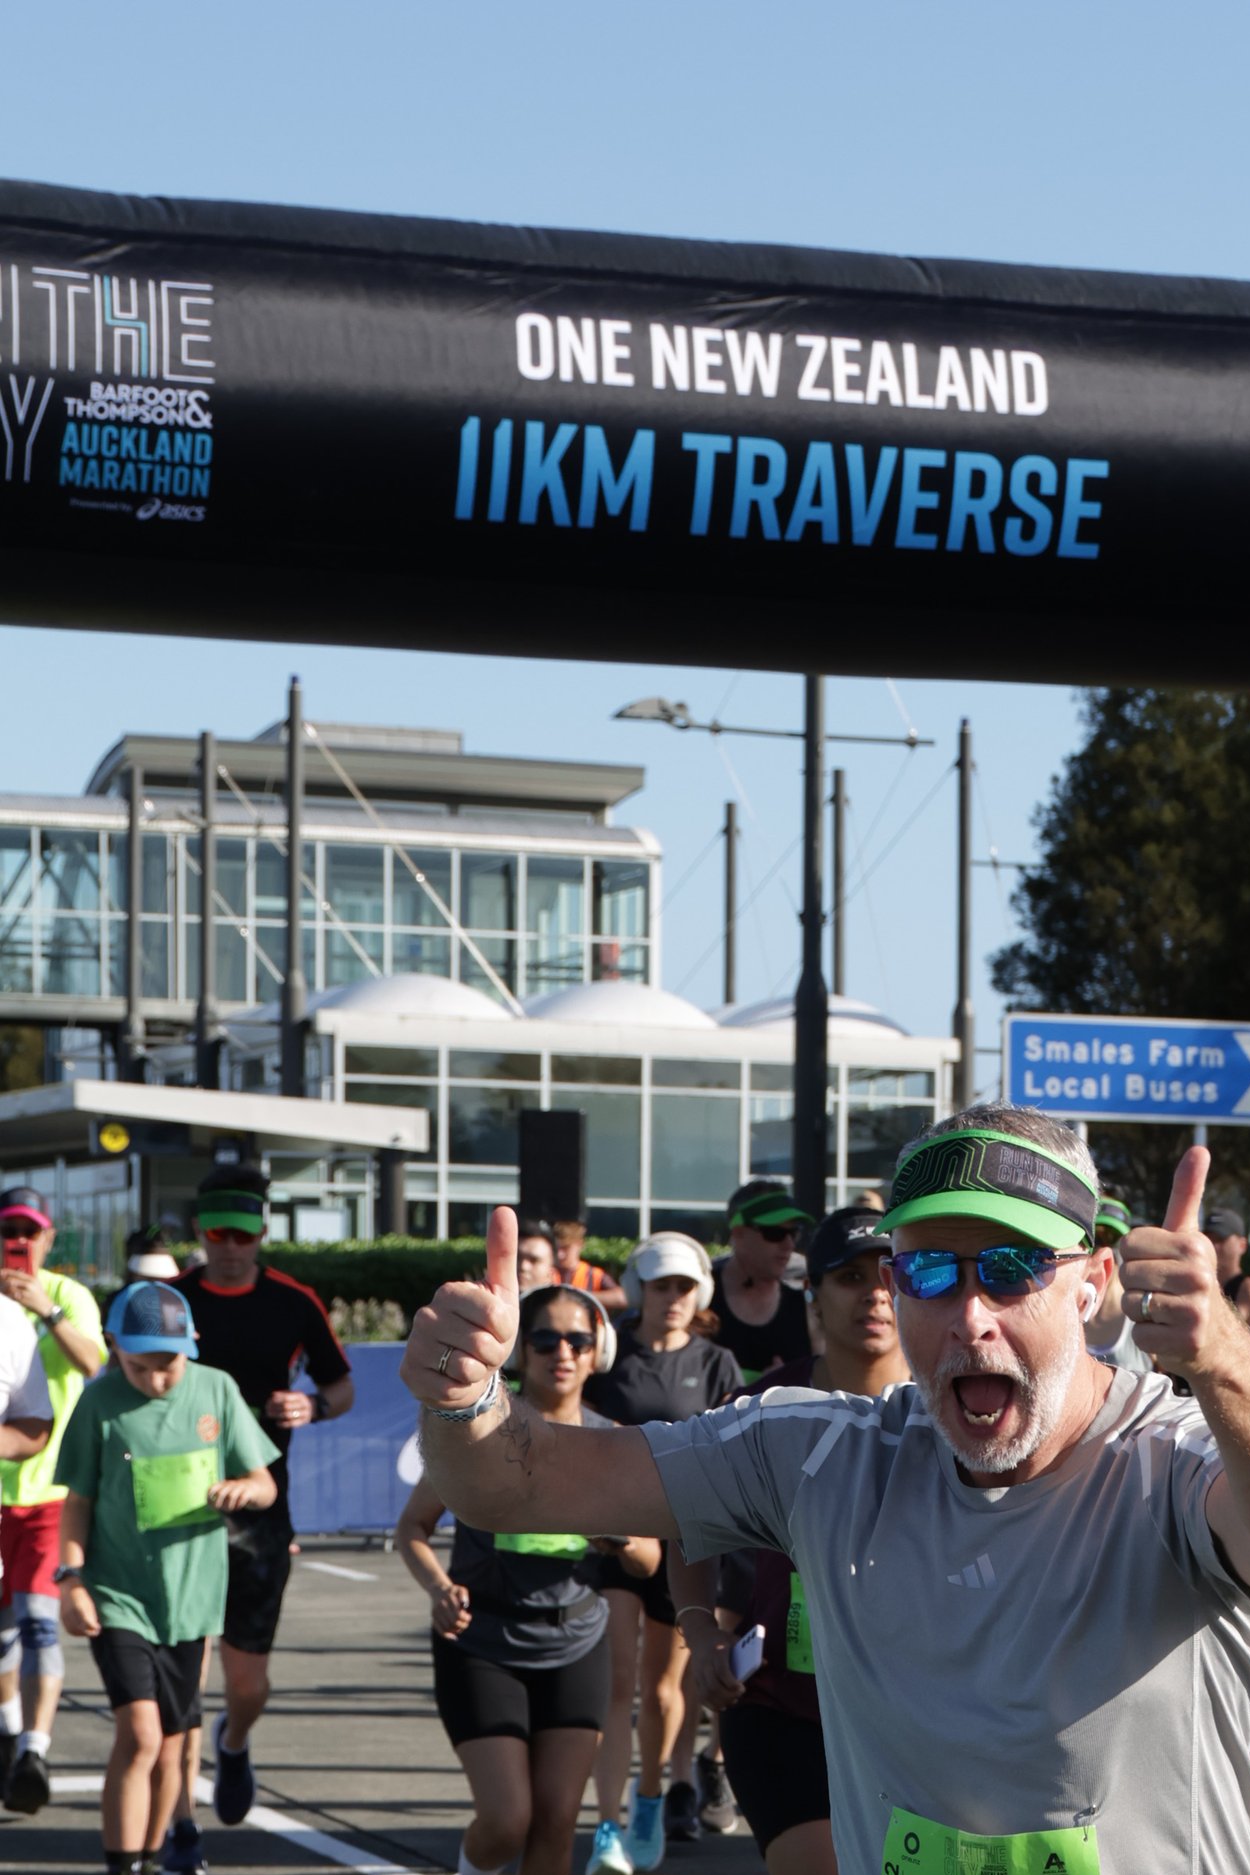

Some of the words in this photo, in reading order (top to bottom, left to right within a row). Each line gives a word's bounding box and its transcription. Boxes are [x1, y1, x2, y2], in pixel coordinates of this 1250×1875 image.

[32, 266, 216, 384] THE
[515, 313, 635, 387] ONE
[650, 322, 783, 398] NEW
[796, 334, 1049, 417] ZEALAND
[63, 396, 183, 428] THOMPSON
[61, 421, 213, 467] AUCKLAND
[58, 456, 211, 498] MARATHON
[681, 431, 1110, 560] TRAVERSE
[1024, 1034, 1135, 1067] Smales
[1149, 1038, 1226, 1069] Farm
[1023, 1070, 1110, 1100] Local
[1125, 1074, 1219, 1104] Buses
[787, 1602, 802, 1644] 32899
